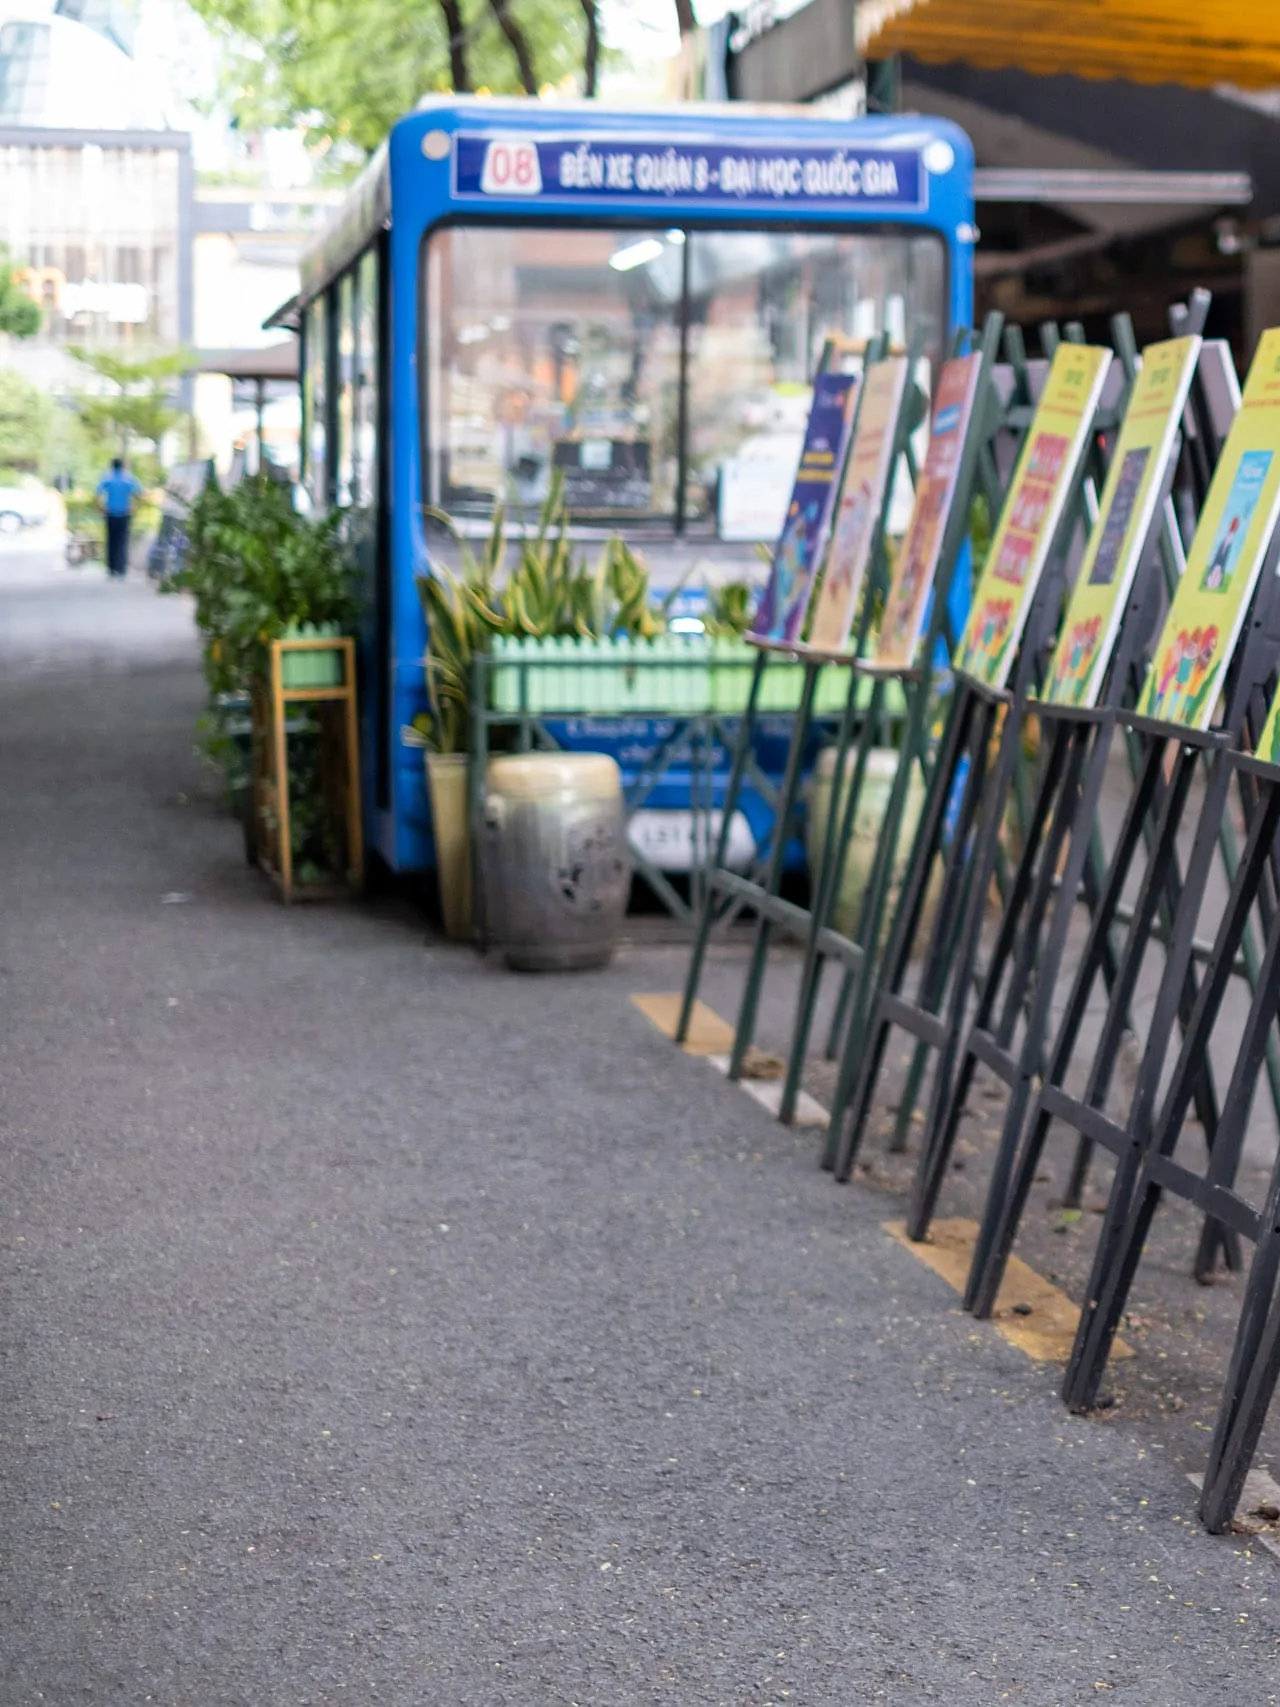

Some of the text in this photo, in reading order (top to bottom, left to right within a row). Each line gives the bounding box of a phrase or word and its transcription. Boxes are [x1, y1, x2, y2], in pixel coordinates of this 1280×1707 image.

[492, 148, 533, 185] 08
[605, 153, 633, 189] XE
[635, 147, 692, 197] QUẬN
[758, 157, 801, 199] HỌC
[803, 148, 861, 196] QUỐC
[862, 159, 899, 196] GIA
